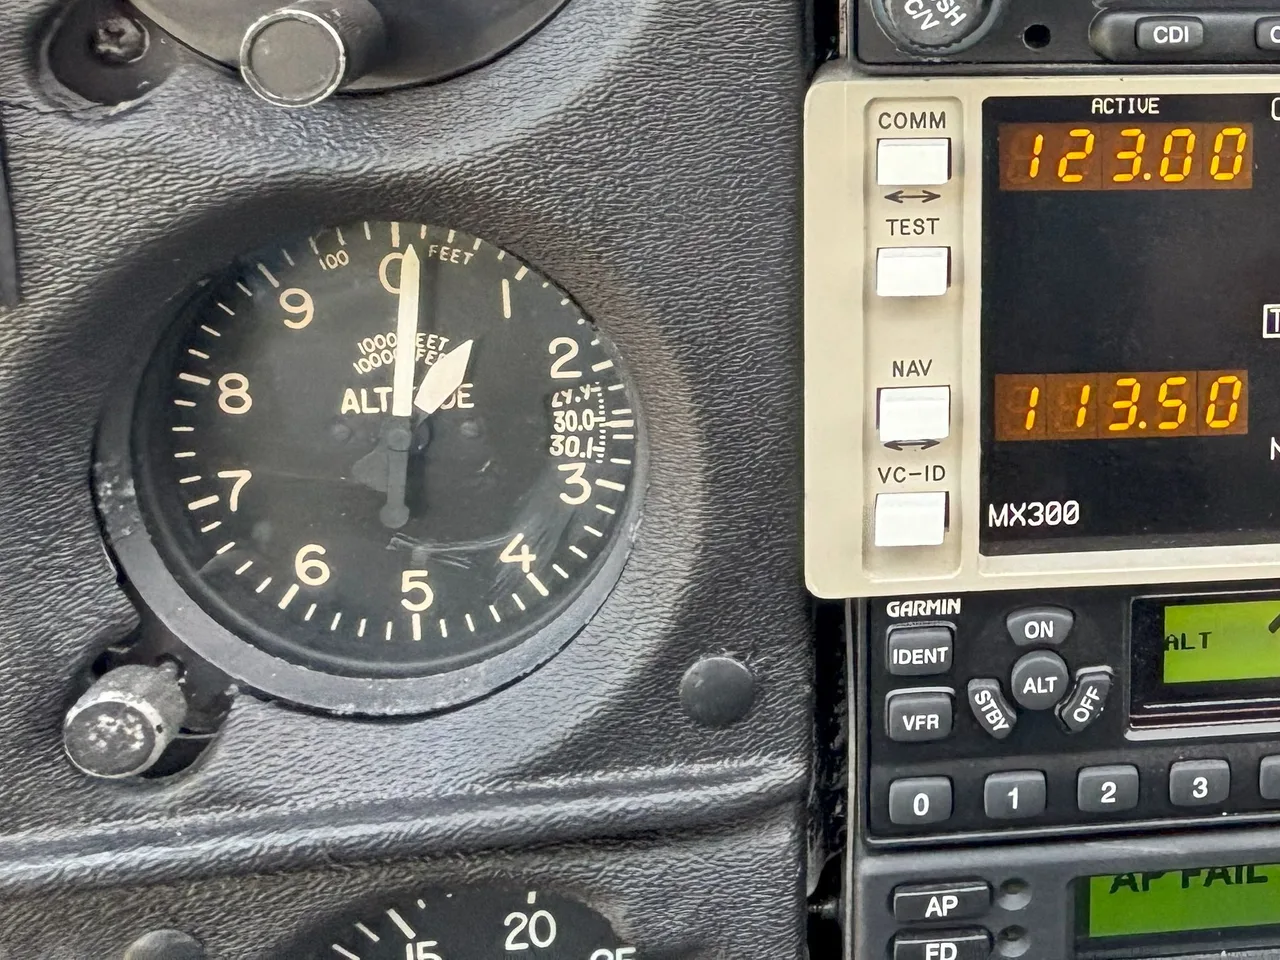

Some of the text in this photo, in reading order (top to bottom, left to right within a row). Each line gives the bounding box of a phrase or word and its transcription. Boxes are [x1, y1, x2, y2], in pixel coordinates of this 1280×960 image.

[1153, 25, 1189, 43] CDI
[1092, 98, 1160, 114] ACTIVE
[878, 111, 946, 130] COMM
[1029, 127, 1247, 183] 123.00
[885, 218, 940, 236] TEST
[319, 250, 349, 270] 100
[428, 244, 474, 265] FEET
[892, 359, 933, 378] NAV
[1025, 375, 1242, 431] 113.50
[553, 409, 595, 432] 30.0
[550, 435, 593, 459] 30.1
[877, 465, 946, 484] VC-ID
[988, 500, 1080, 527] MX300
[886, 598, 961, 618] GARMIN
[1024, 621, 1053, 639] ON
[1164, 632, 1212, 651] ALT
[893, 647, 948, 665] IDENT
[1022, 676, 1058, 694] ALT
[974, 690, 1010, 733] STBY
[1073, 685, 1101, 724] OFF
[902, 714, 939, 731] VFR
[925, 895, 959, 918] AP
[504, 910, 557, 951] 20
